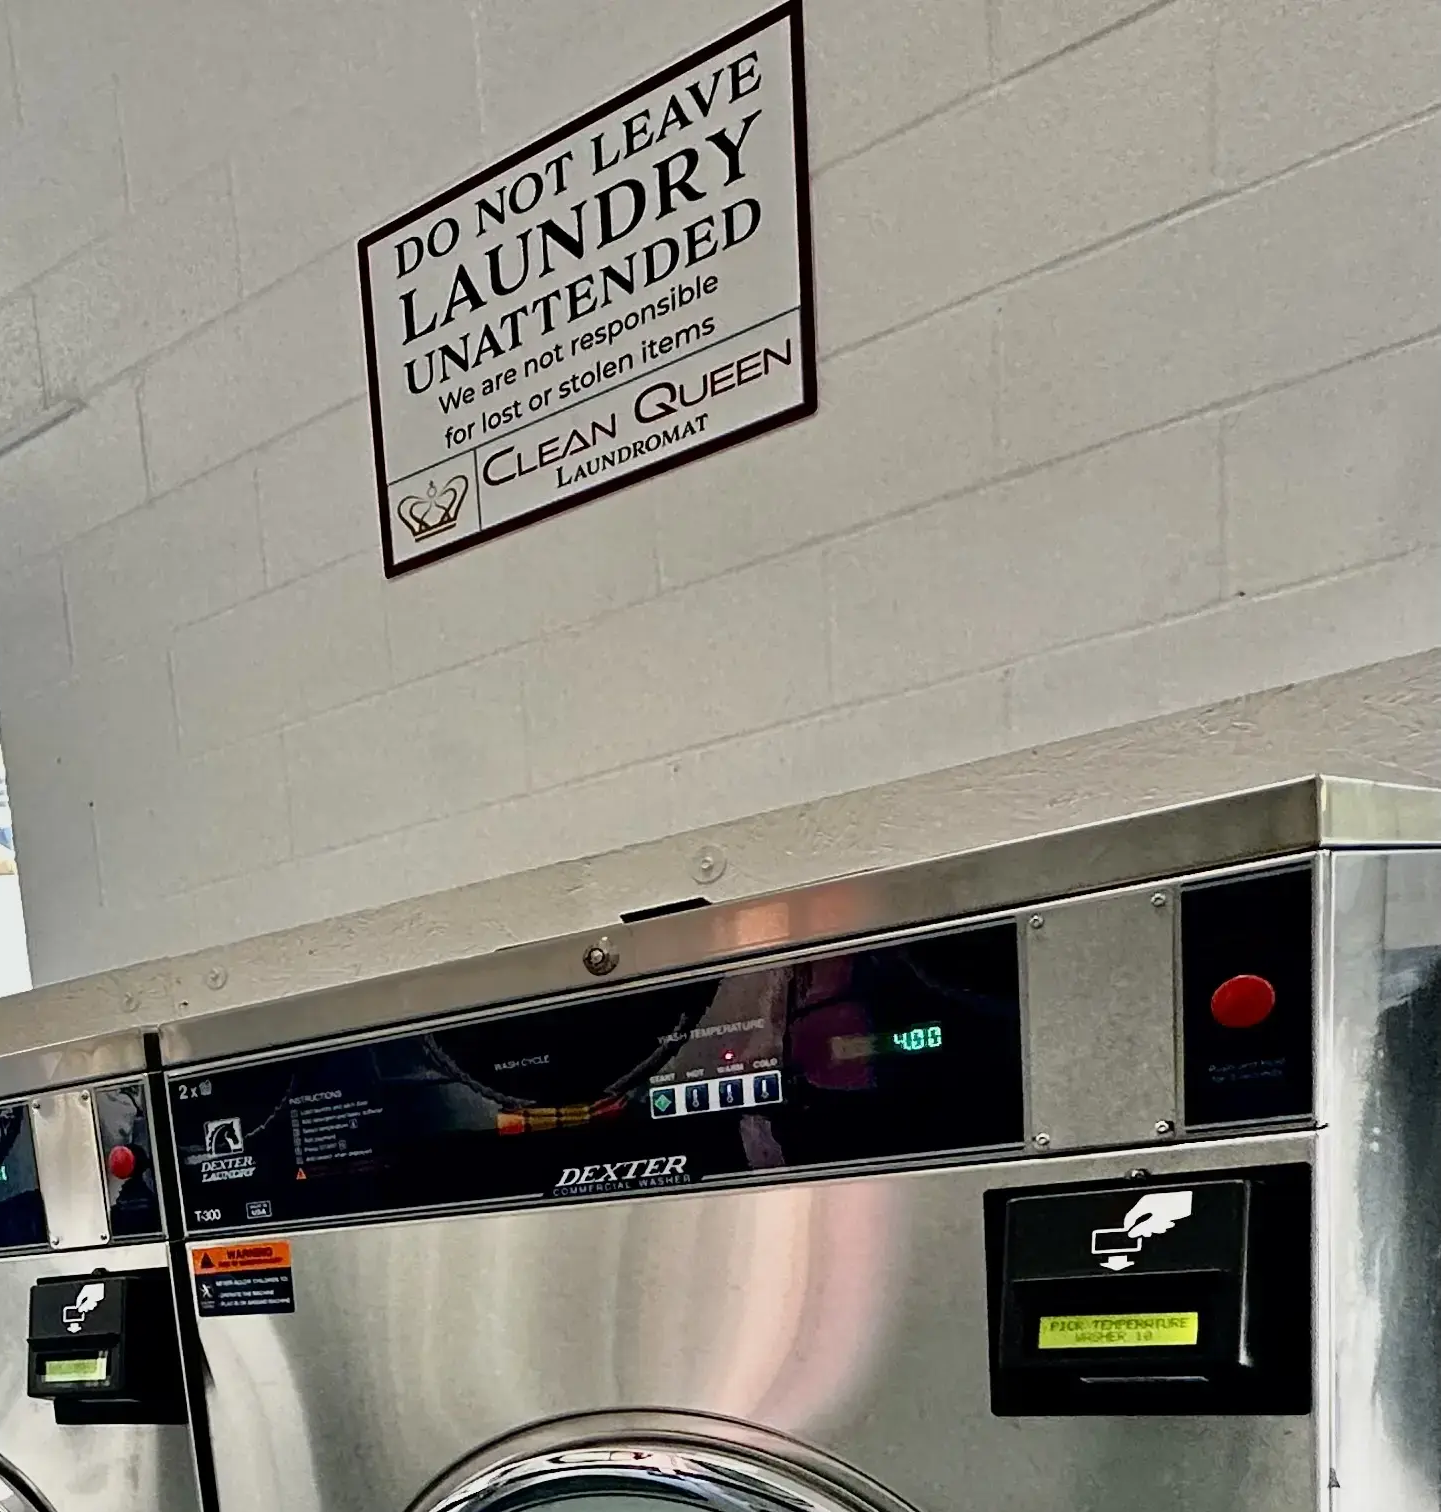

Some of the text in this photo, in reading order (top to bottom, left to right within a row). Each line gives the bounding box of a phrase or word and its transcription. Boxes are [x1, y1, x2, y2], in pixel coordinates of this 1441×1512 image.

[394, 50, 762, 280] DO NOT LEAVE
[398, 109, 763, 346] LAUNDRY
[403, 197, 762, 395] UNATTENDED
[438, 275, 719, 414] We are not responsible
[444, 316, 716, 449] for lost or stolen items
[482, 337, 792, 487] CLEAN QUEEN
[555, 412, 709, 489] LAUNDROMAT
[689, 1018, 766, 1040] TEMPERATURE
[521, 1054, 551, 1067] CYCLE
[178, 1084, 189, 1100] 2
[200, 1155, 254, 1173] DEXTER
[552, 1173, 692, 1197] COMMERCIAL WASHER
[554, 1154, 688, 1188] DEXTER
[1049, 1317, 1191, 1332] PICK TEMPERATURE
